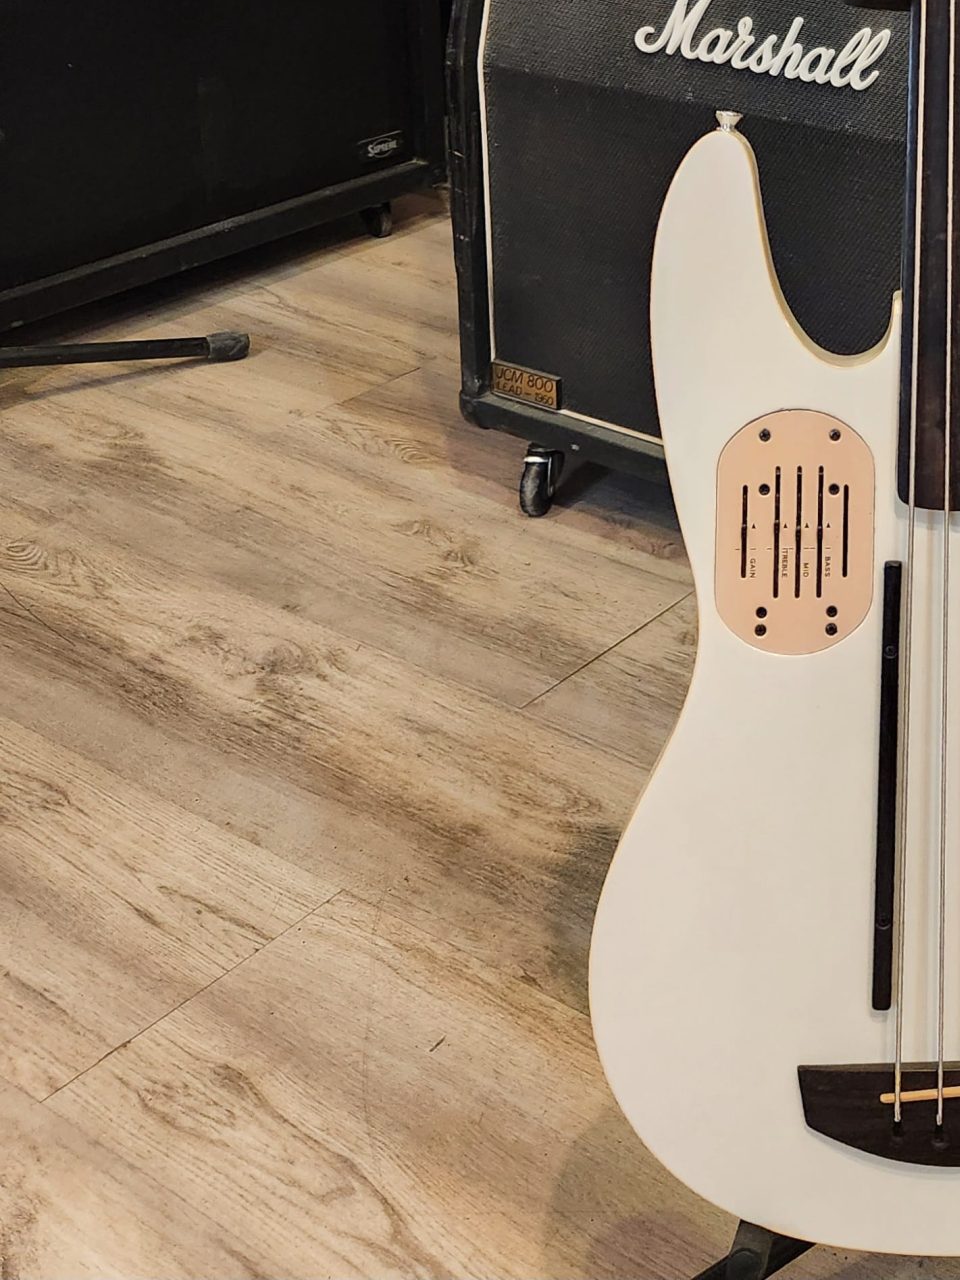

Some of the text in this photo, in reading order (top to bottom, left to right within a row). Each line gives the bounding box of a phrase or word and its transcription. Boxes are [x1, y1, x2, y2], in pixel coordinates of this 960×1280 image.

[496, 367, 554, 393] JCM 800
[496, 381, 522, 396] LEAD
